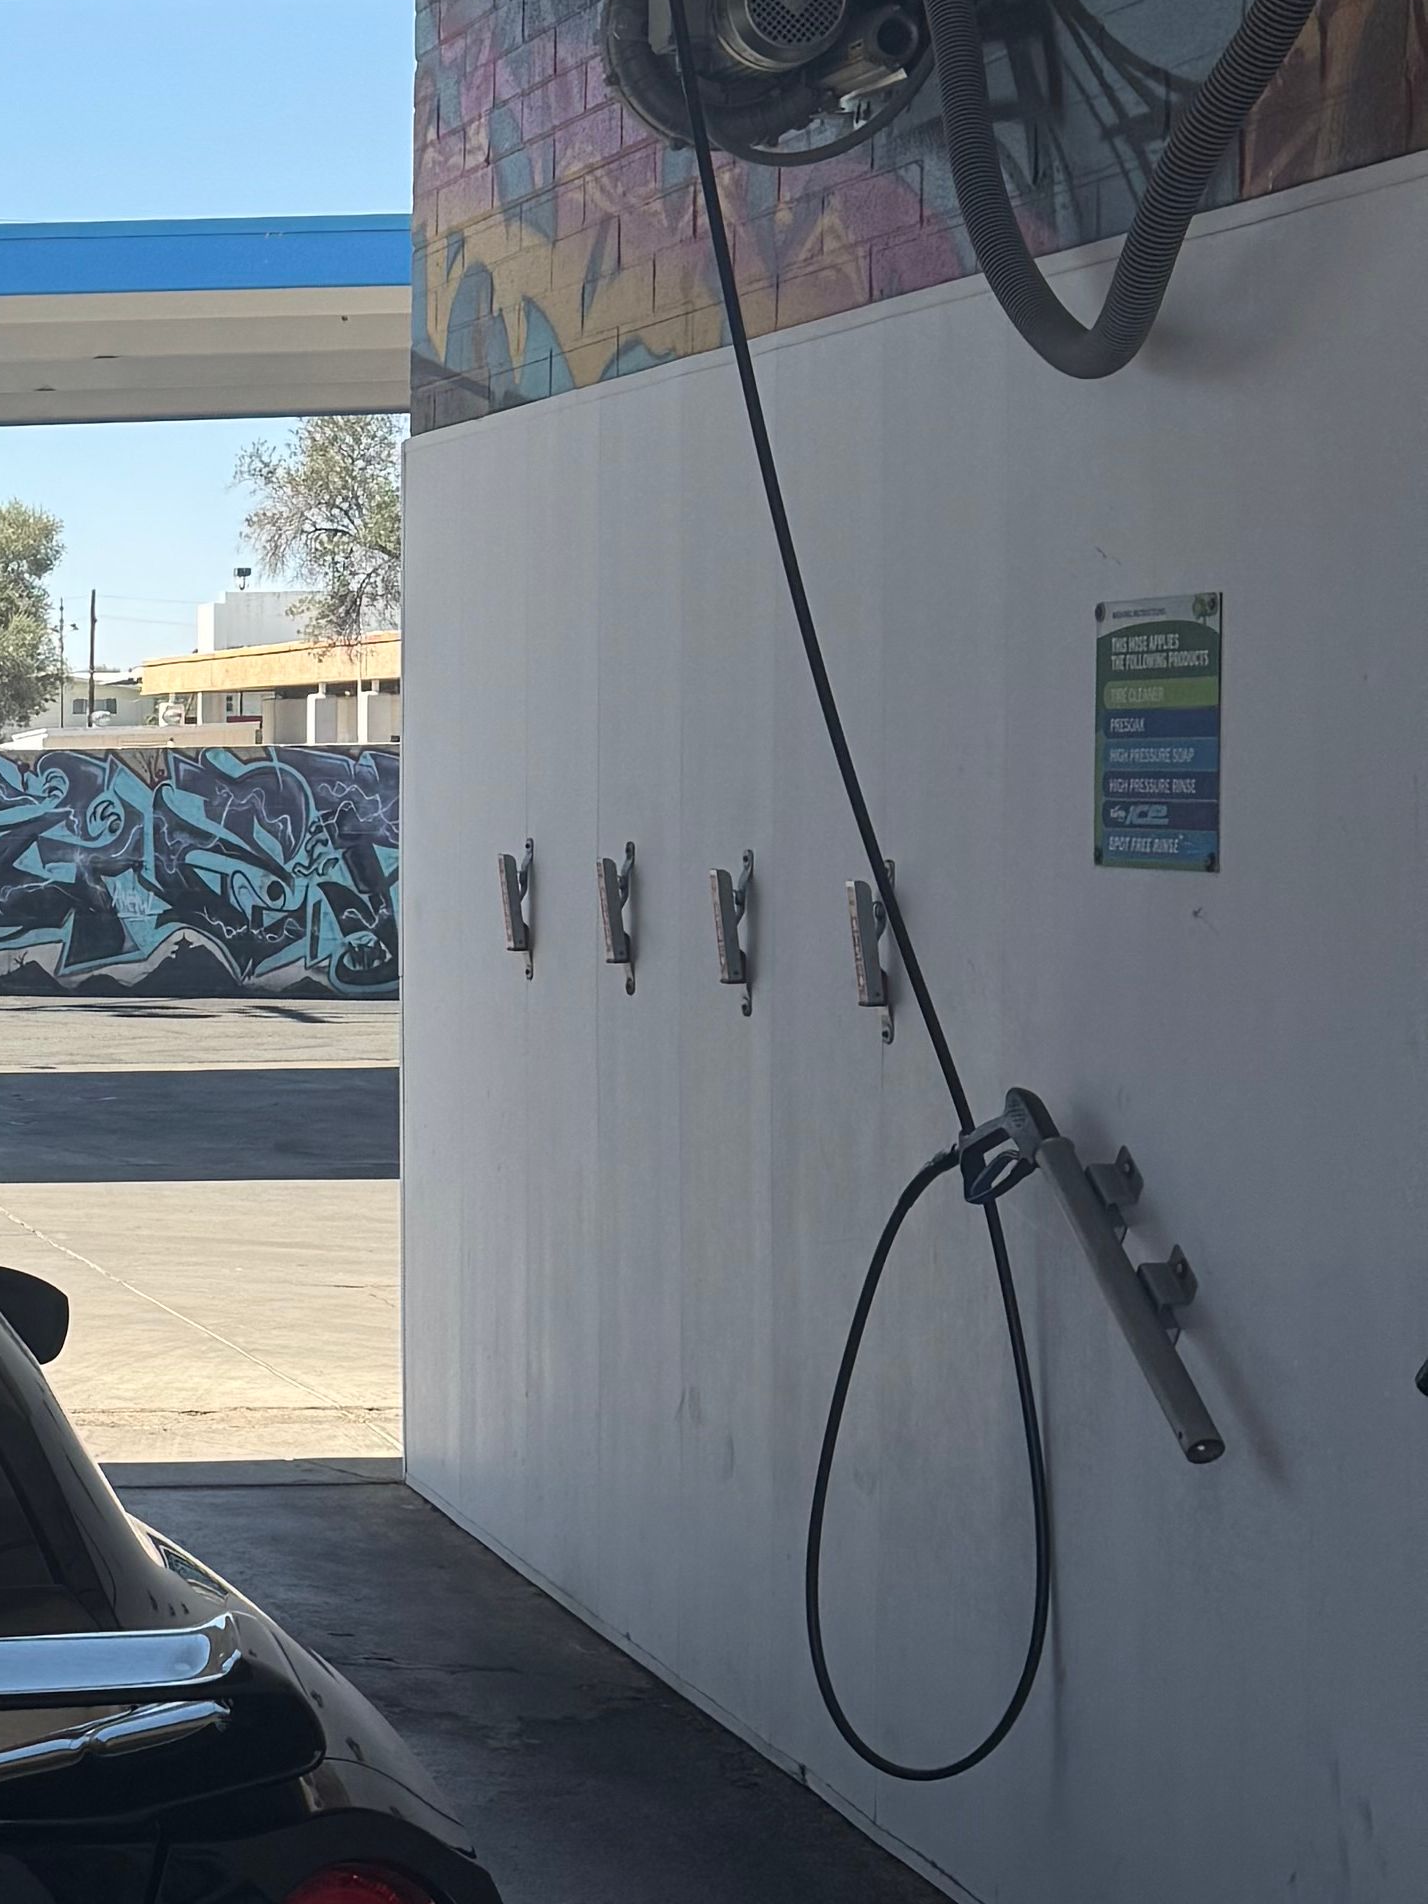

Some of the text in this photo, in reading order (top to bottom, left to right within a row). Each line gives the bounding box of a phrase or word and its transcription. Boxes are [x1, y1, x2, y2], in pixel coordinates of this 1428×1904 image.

[1112, 634, 1179, 652] THIS HOSE APPLIES
[1111, 650, 1209, 670] THE FOLLOWING PRODUCTS
[1110, 718, 1145, 733] PRESOAK
[1109, 747, 1195, 763] HIGH PRESSURE SOAP
[1109, 779, 1196, 793] HIGH PRESSURE RINSE
[1108, 836, 1129, 851] SPOT
[1130, 837, 1152, 852] FREE
